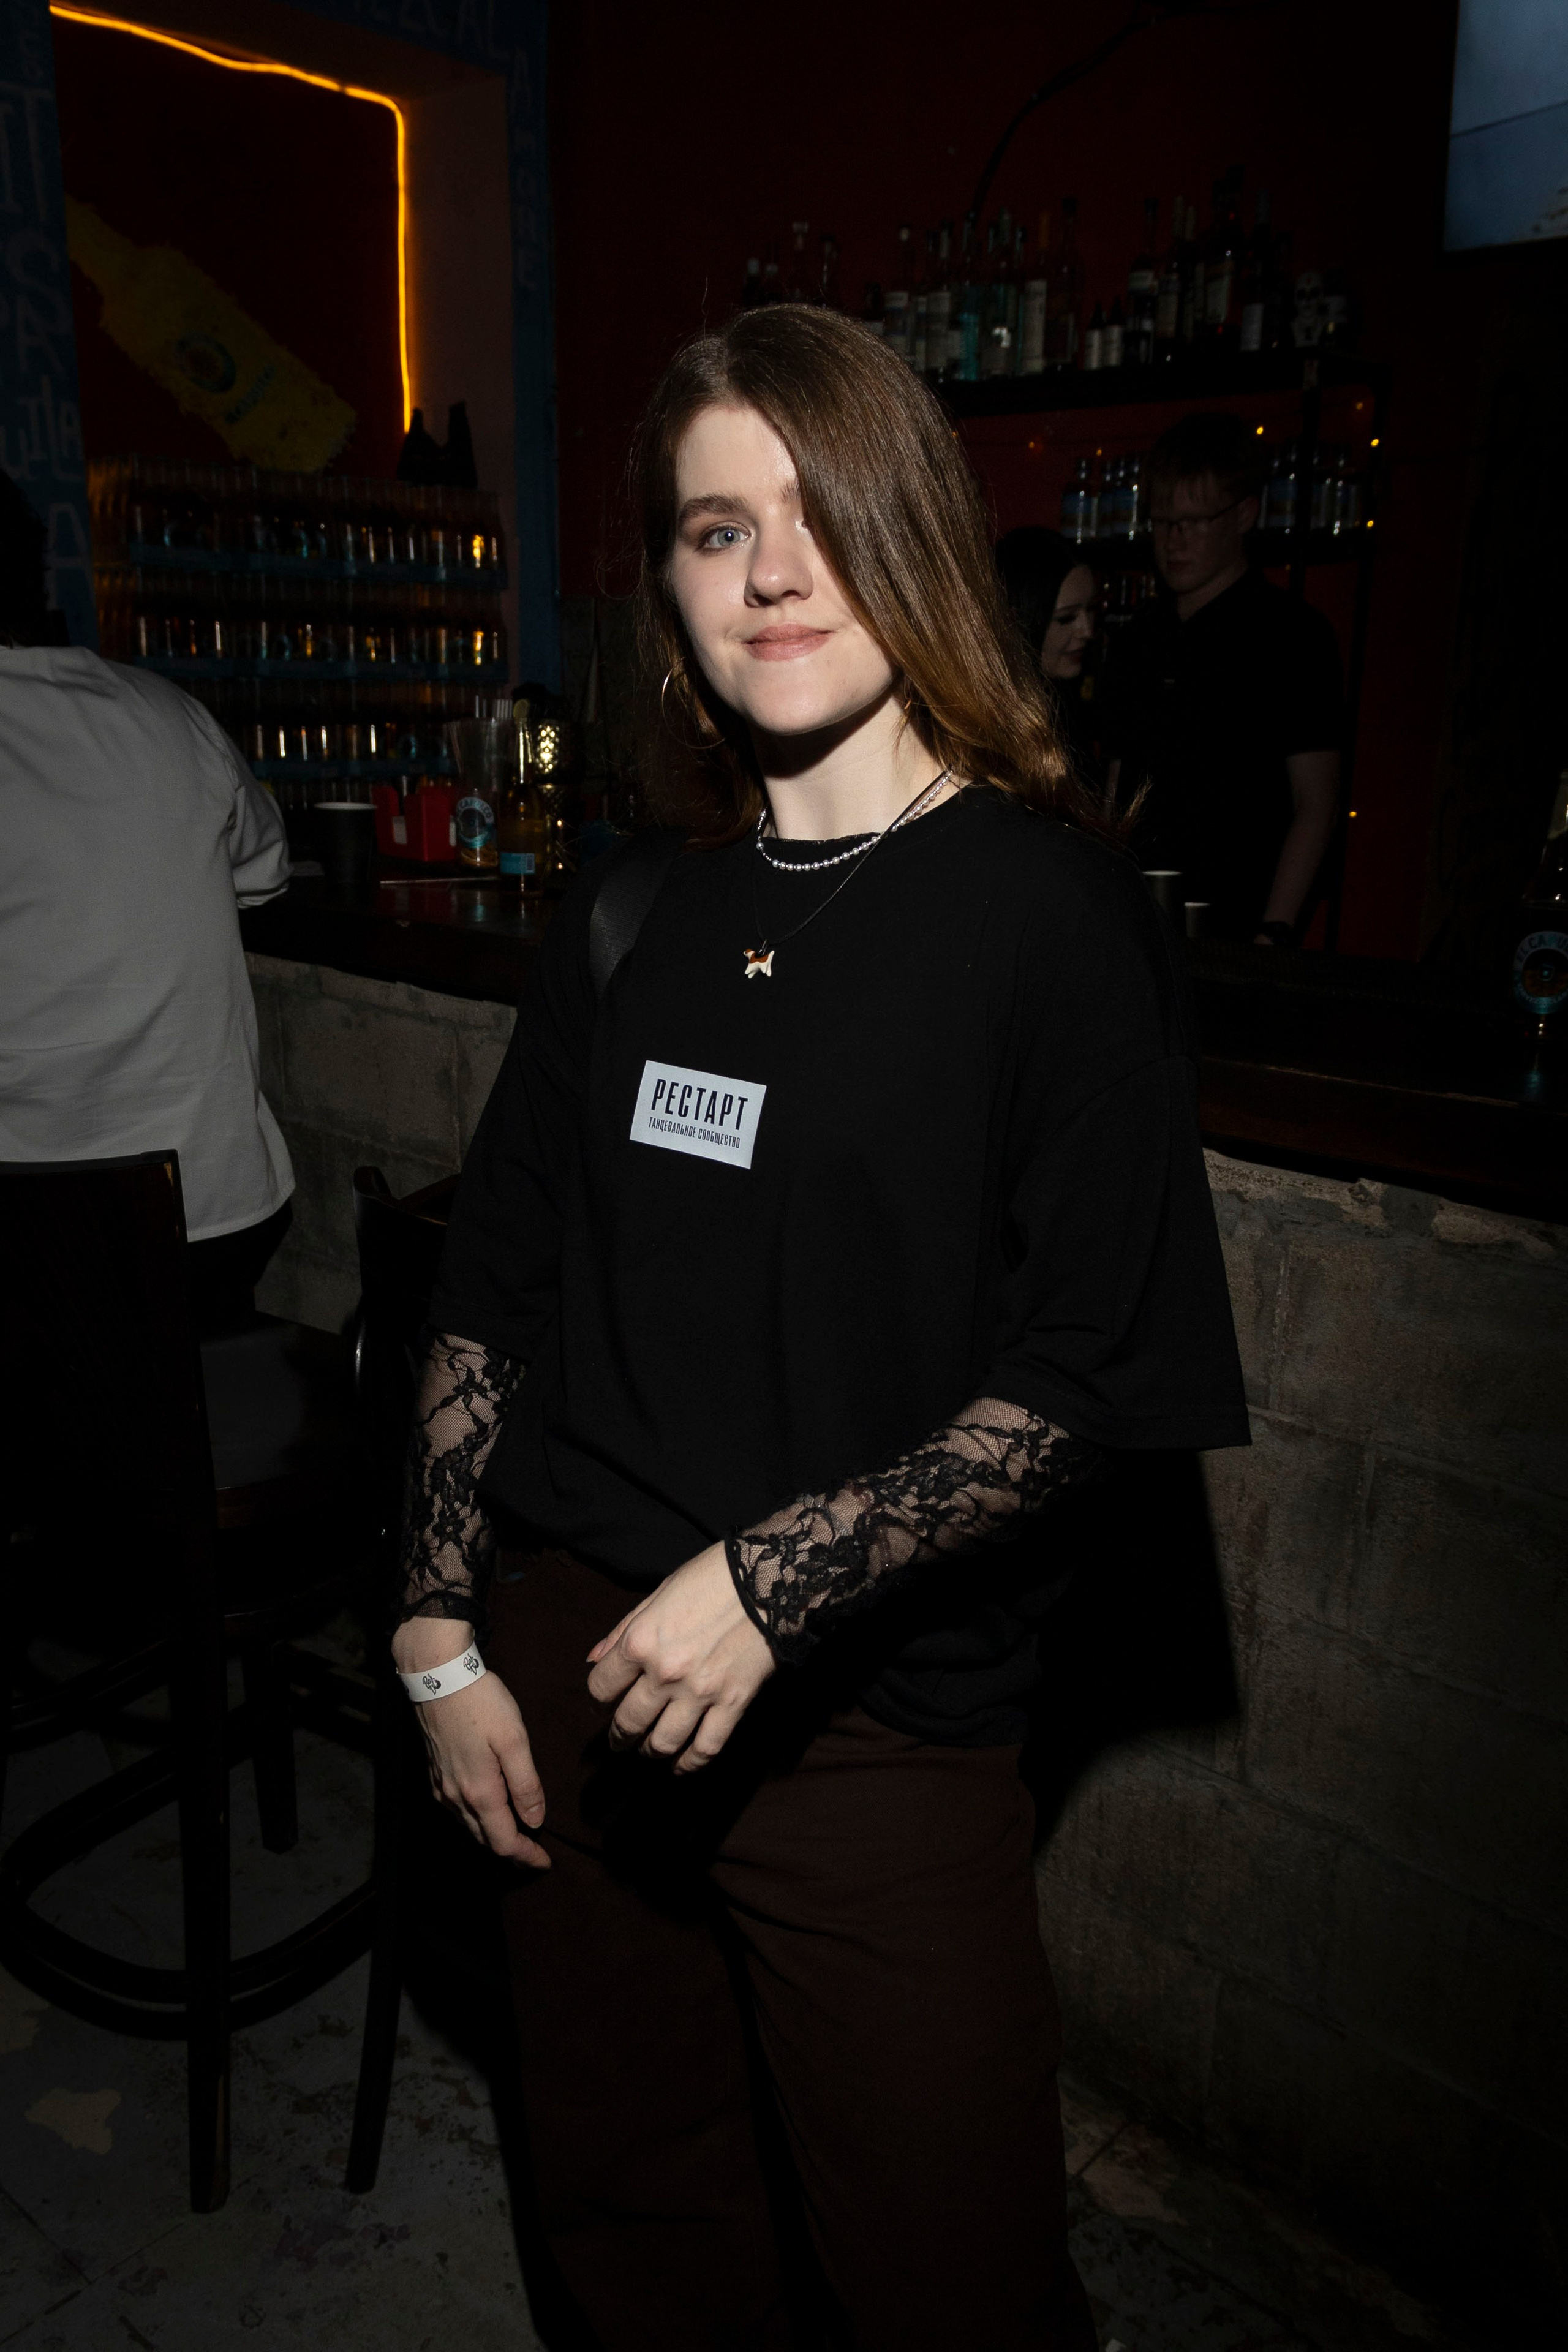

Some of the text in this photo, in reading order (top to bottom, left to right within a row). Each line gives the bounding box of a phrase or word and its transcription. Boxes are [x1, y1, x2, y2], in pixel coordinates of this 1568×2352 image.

[651, 1079, 748, 1131] РЕСТАРТ
[649, 1117, 741, 1148] ТАНЦЕВАЛЬНОЕ СООБЩЕСТВО
